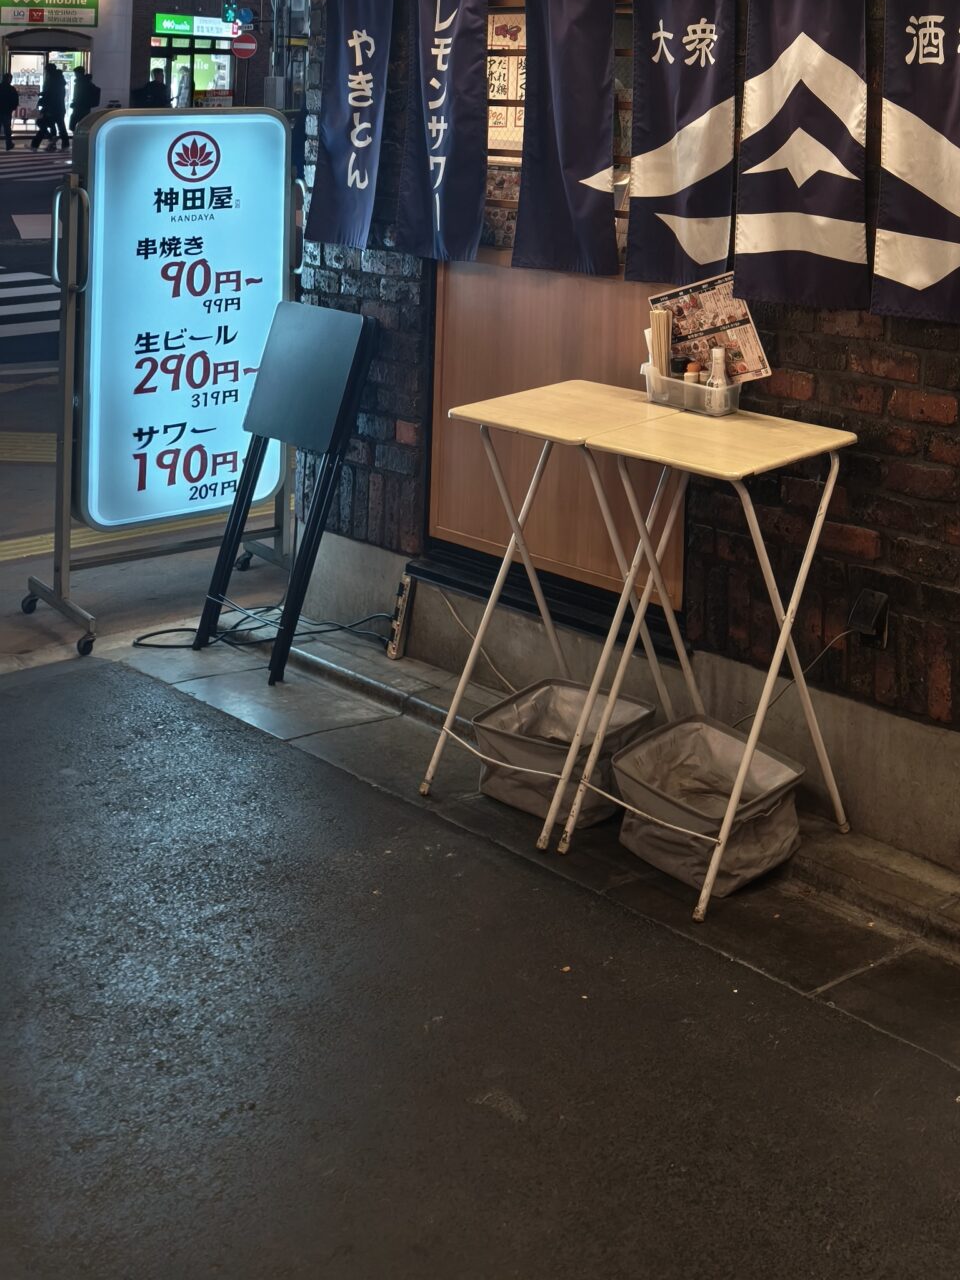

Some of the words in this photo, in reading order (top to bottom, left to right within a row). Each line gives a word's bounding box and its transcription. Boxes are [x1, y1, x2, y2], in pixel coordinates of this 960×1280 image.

[652, 18, 719, 68] 大衆
[347, 29, 376, 190] やきとん
[153, 186, 233, 214] 神田屋
[170, 213, 215, 223] KANDAYA
[136, 235, 204, 260] 串焼き
[202, 297, 241, 314] 99円
[134, 324, 239, 355] 生ビール
[191, 389, 239, 409] 319円
[132, 421, 218, 451] サワー
[133, 444, 243, 492] 190円
[188, 480, 237, 502] 209円
